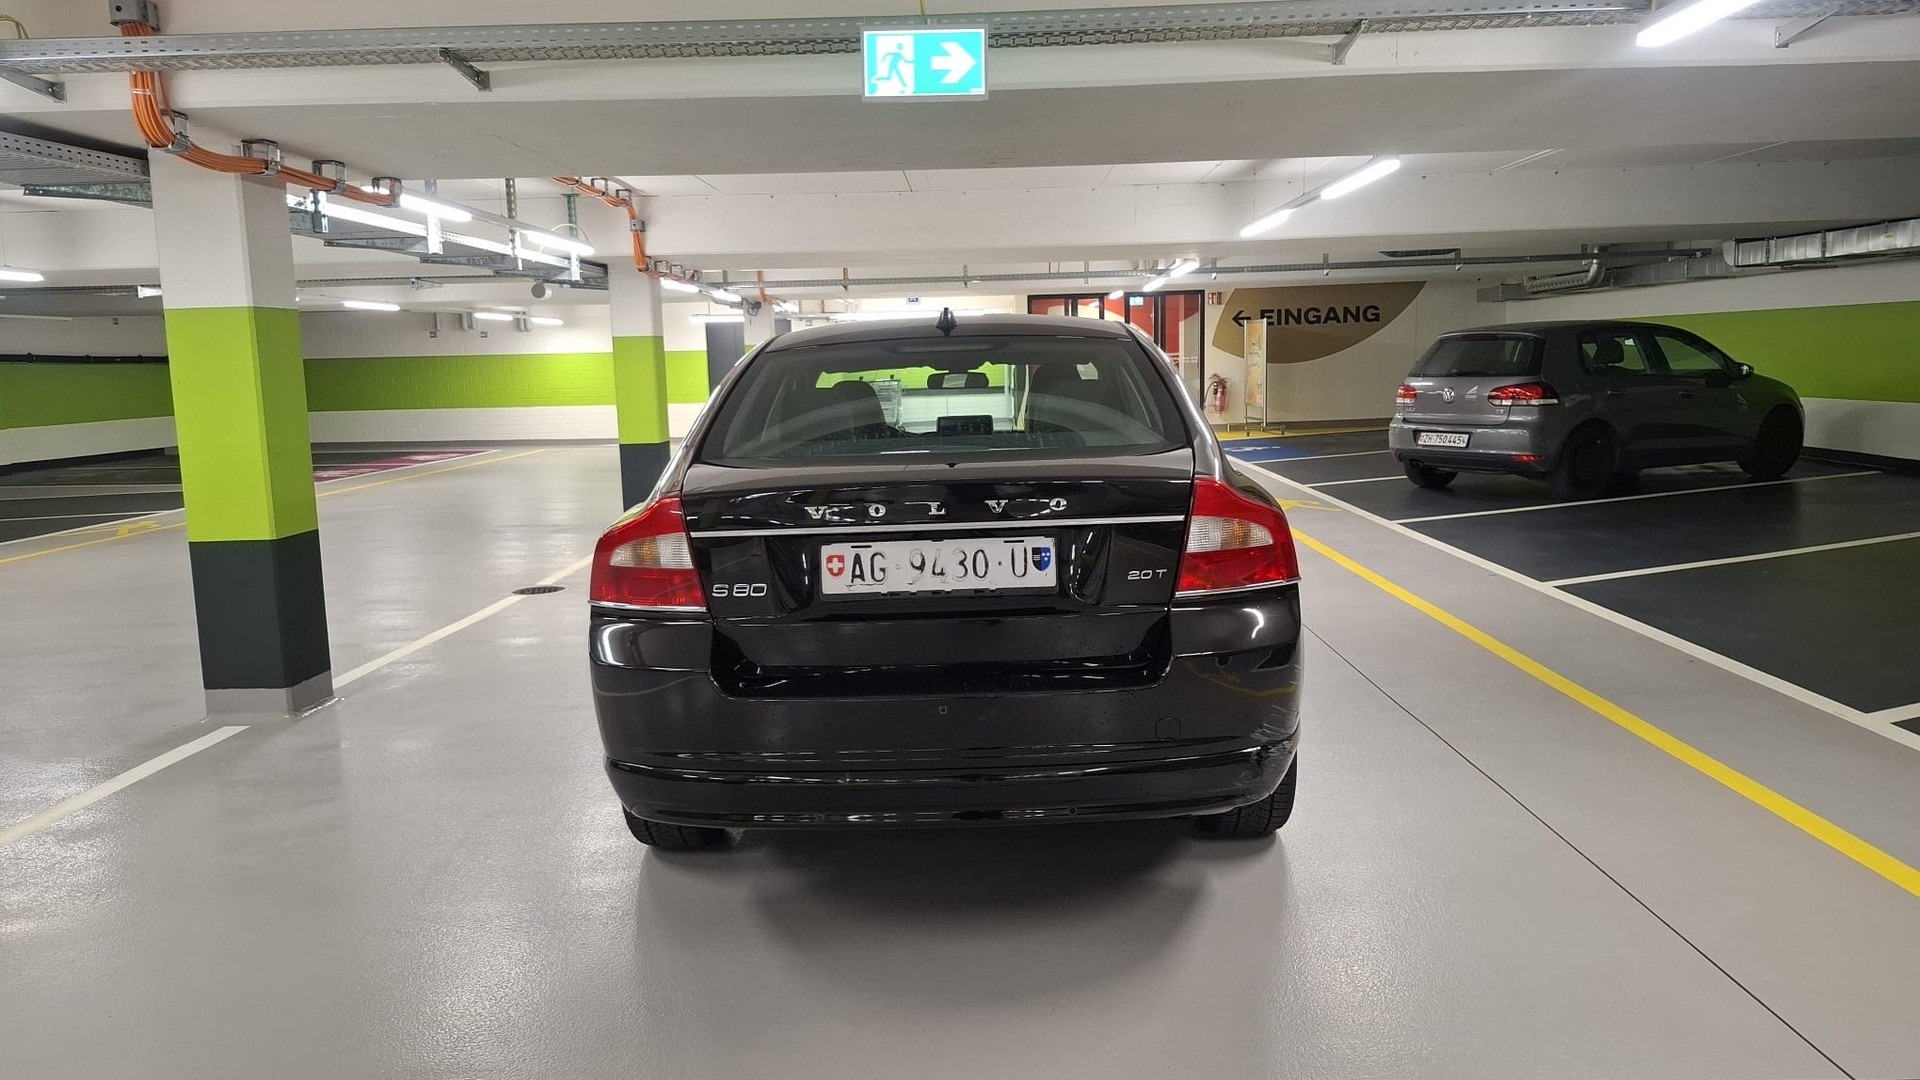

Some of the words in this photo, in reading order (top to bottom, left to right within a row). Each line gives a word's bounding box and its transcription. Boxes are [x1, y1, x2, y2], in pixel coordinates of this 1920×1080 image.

[1259, 304, 1381, 326] EINGANG
[804, 497, 1067, 520] VOLVO
[850, 551, 887, 583] AG
